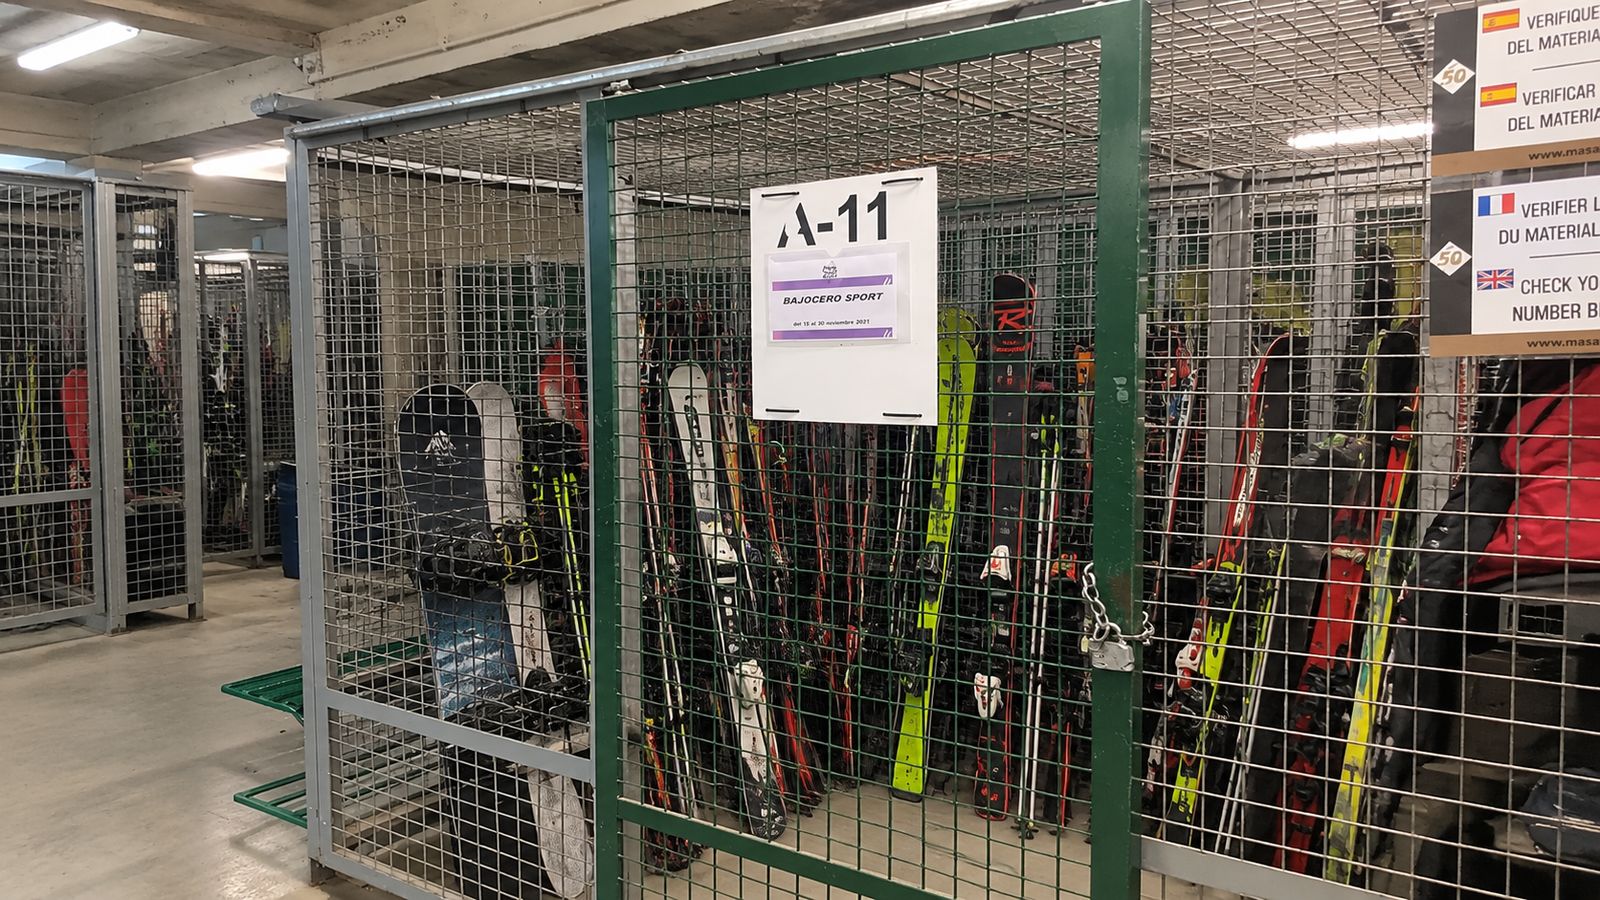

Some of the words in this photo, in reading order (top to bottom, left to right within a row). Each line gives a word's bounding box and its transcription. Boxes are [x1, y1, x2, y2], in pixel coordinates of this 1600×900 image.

[1527, 5, 1600, 30] VERIFIQUE
[1507, 39, 1534, 55] DEL
[1442, 68, 1467, 86] 50
[1522, 83, 1596, 106] VERIFICAR
[1508, 117, 1534, 132] DEL
[1521, 198, 1588, 218] VERIFIER
[777, 191, 887, 248] A-11
[1499, 229, 1520, 245] DU
[1525, 222, 1600, 242] MATERIAL
[1437, 250, 1463, 266] 50
[1521, 277, 1572, 295] CHECK
[783, 294, 842, 305] BAJOCERO
[845, 292, 883, 302] SPORT
[1512, 303, 1581, 322] NUMBER
